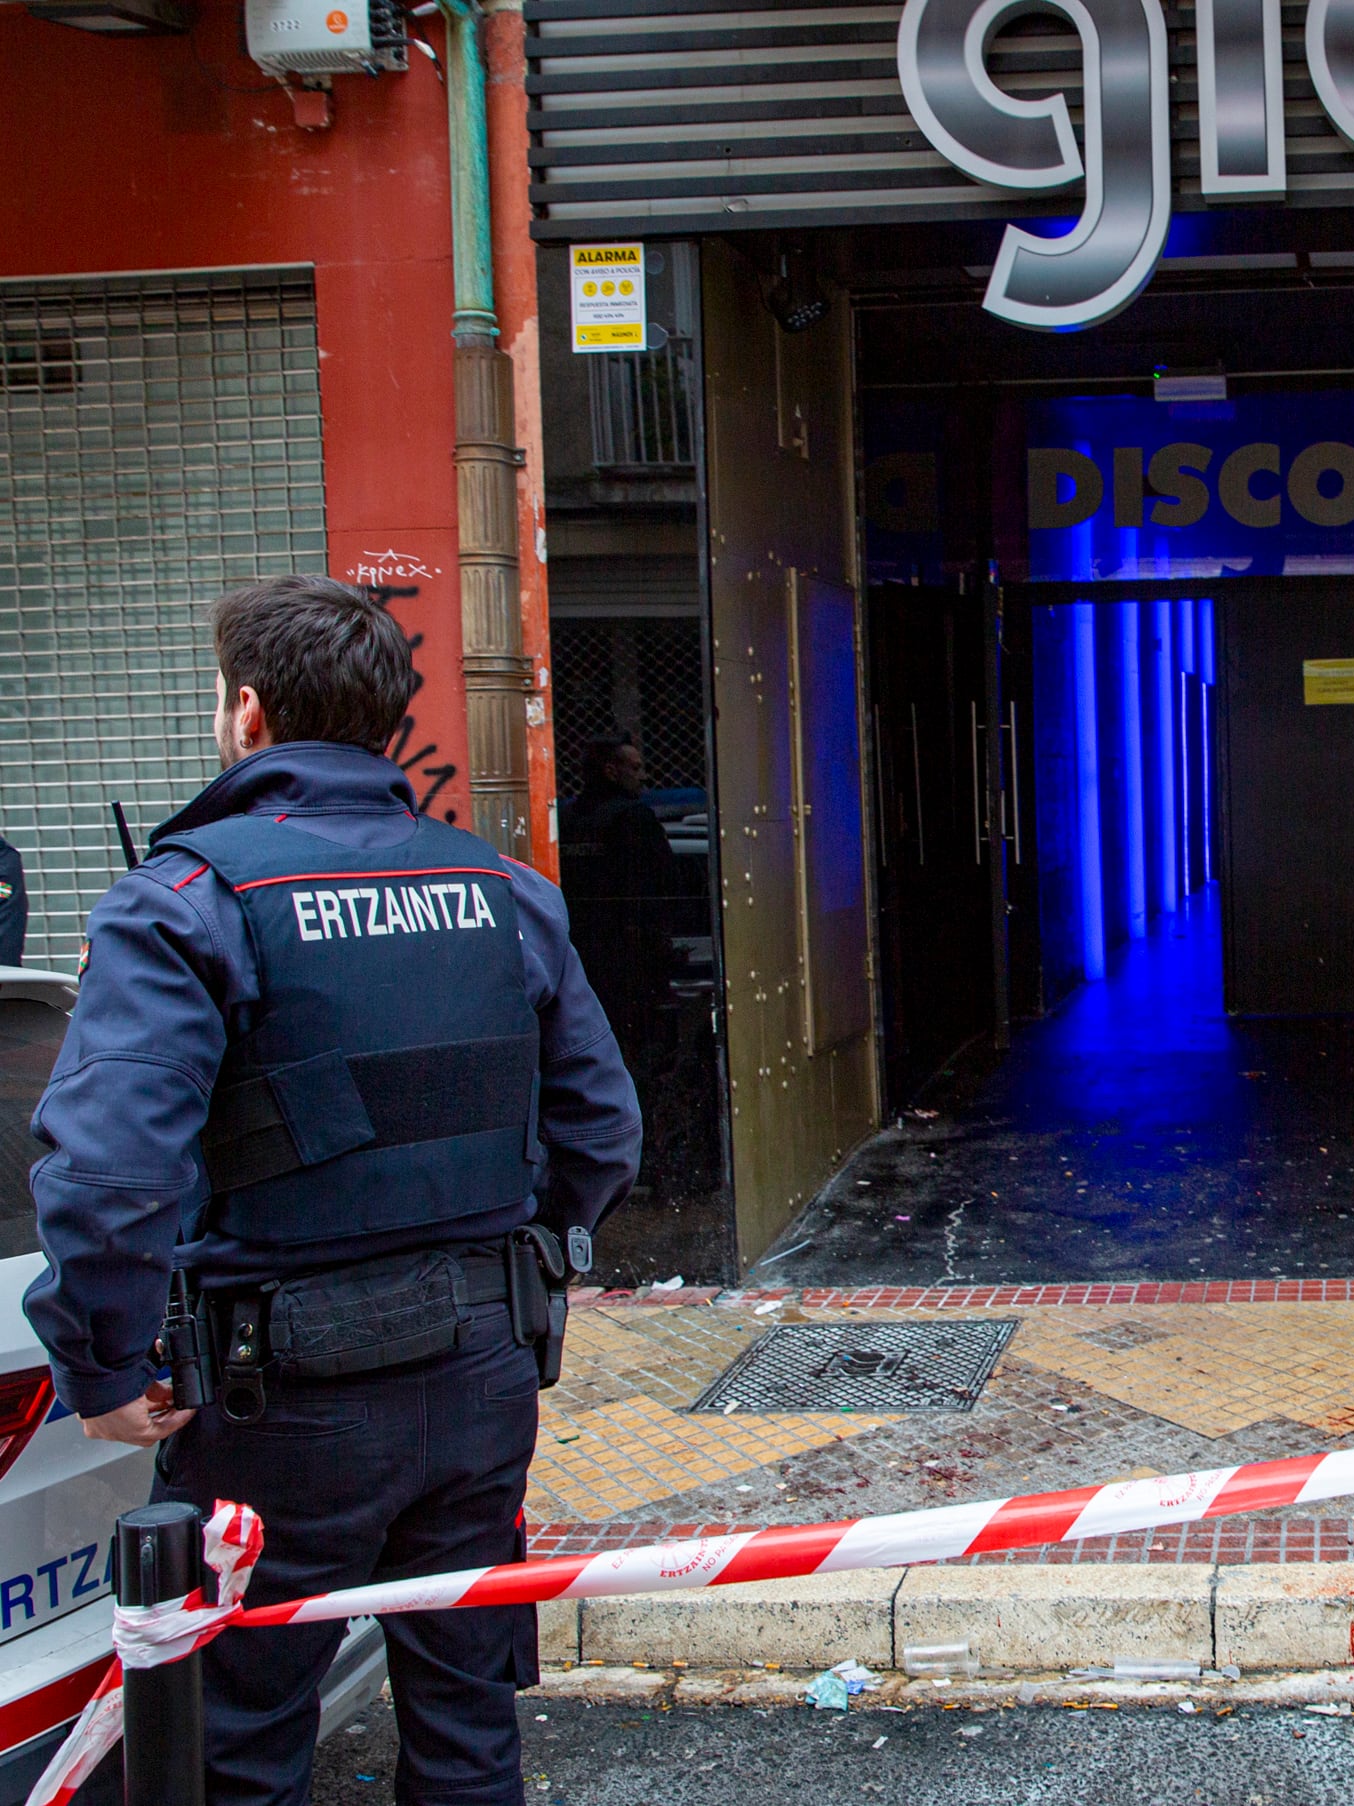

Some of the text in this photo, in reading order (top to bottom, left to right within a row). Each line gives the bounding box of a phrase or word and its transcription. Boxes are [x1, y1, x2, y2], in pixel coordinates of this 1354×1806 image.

[578, 250, 637, 263] ALARMA
[291, 882, 498, 942] ERTZAINTZA
[0, 1541, 113, 1630] RTZ
